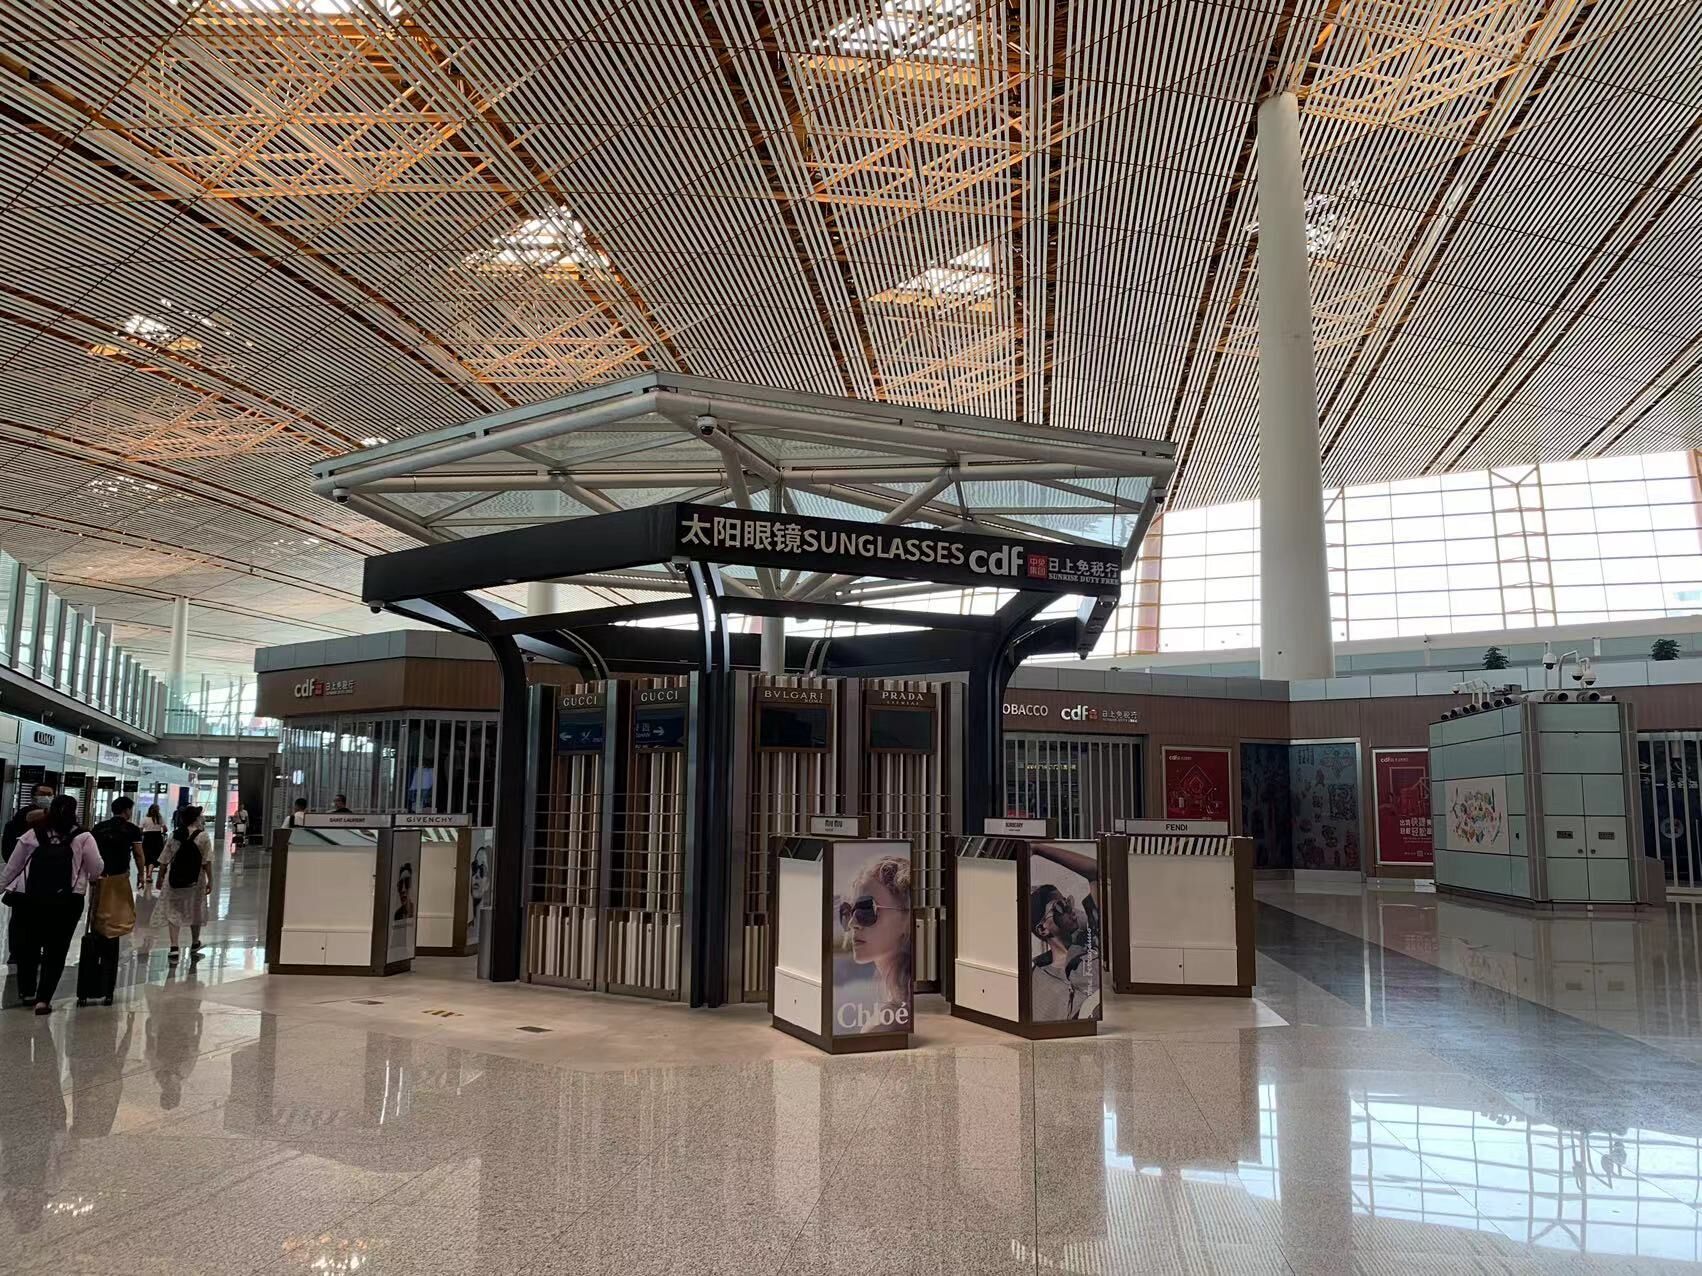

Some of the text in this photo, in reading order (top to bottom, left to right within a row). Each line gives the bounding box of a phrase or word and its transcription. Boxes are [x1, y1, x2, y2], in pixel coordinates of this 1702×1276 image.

[680, 514, 801, 553] 太阳眼镜
[802, 530, 964, 565] SUNGLASSES
[968, 546, 1024, 577] cdf
[1048, 557, 1119, 578] 日上免税行
[1048, 573, 1079, 582] SUNRISE
[1080, 575, 1099, 584] DUTY
[294, 678, 315, 698] cdf
[764, 690, 823, 700] BVLGARI
[563, 695, 597, 707] GUCCI
[640, 690, 678, 702] GUCCI
[882, 691, 924, 701] PRADA
[1002, 703, 1048, 717] OBACCO
[1060, 705, 1089, 721] cdf
[1165, 823, 1188, 832] FENDI
[837, 1001, 909, 1028] Chloé
